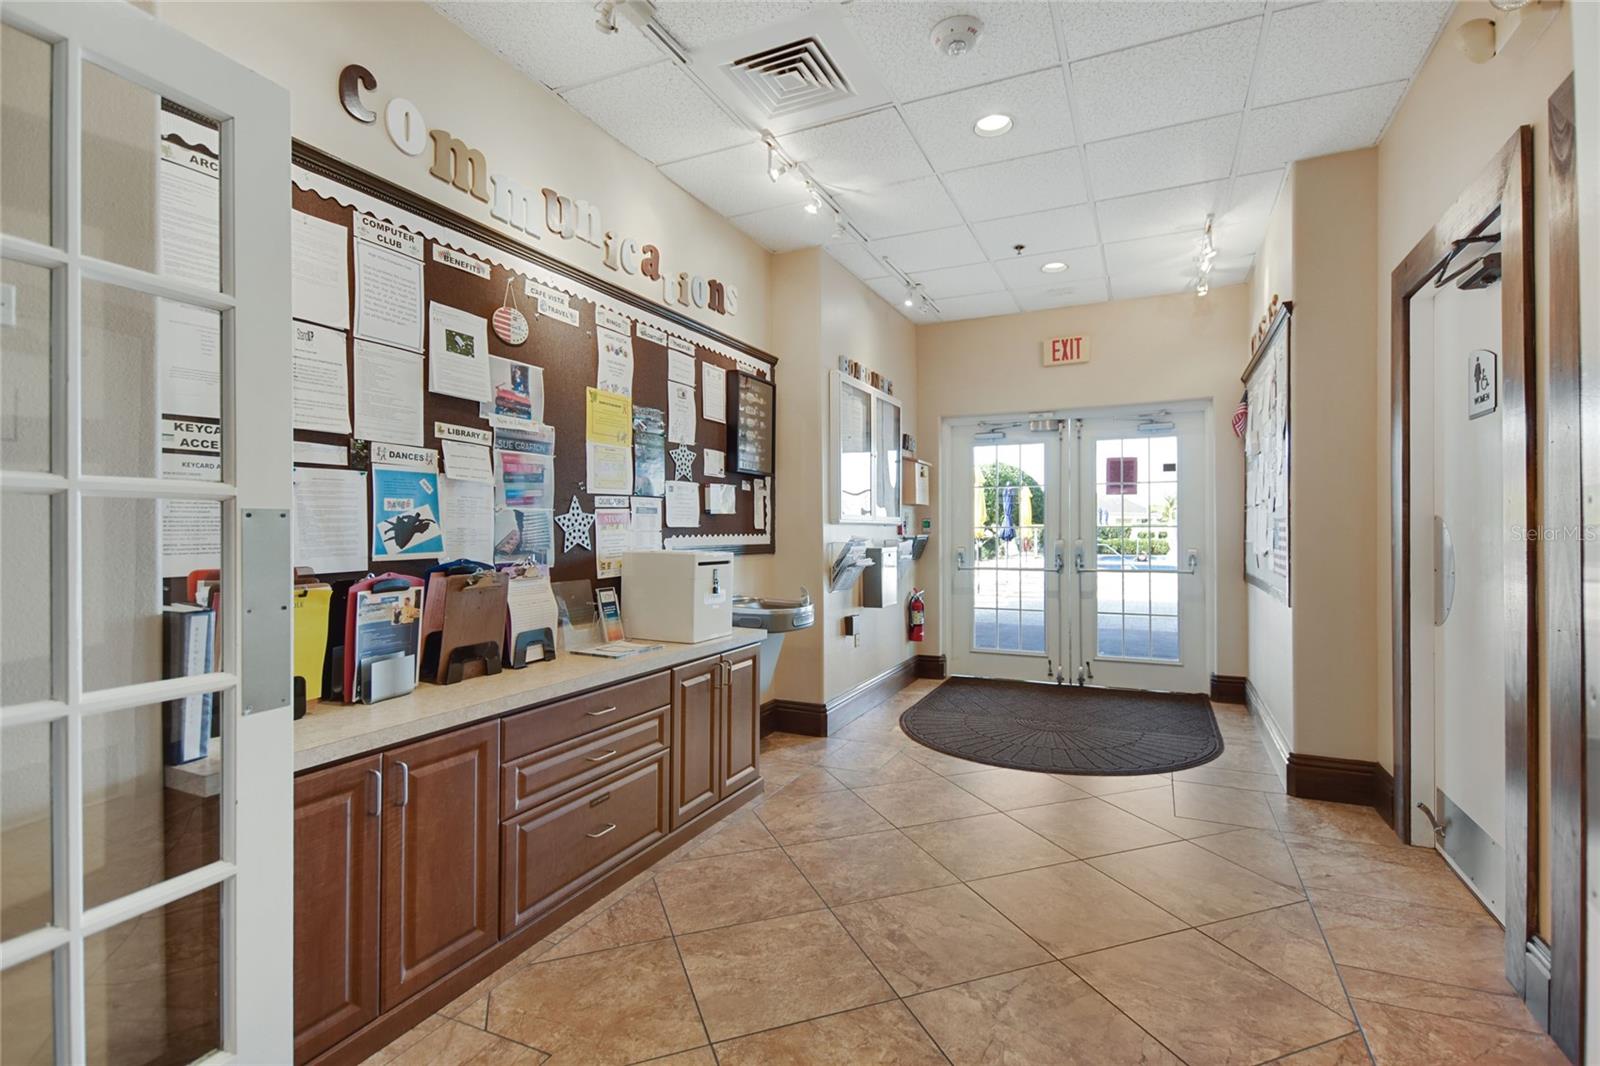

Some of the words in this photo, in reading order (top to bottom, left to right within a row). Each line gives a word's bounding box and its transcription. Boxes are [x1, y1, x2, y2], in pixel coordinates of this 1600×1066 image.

[362, 216, 416, 243] COMPUTER
[376, 234, 403, 250] CLUB
[443, 254, 482, 274] BENEFITS
[530, 287, 547, 299] CAFE
[548, 305, 569, 319] TRAVEL
[1051, 336, 1083, 362] EXIT
[1474, 392, 1490, 405] WOMEN
[447, 426, 481, 440] LIBRARY
[179, 438, 219, 450] ACCE
[497, 439, 515, 450] SUE
[388, 450, 425, 462] DANCES
[181, 461, 215, 470] KEYCARD
